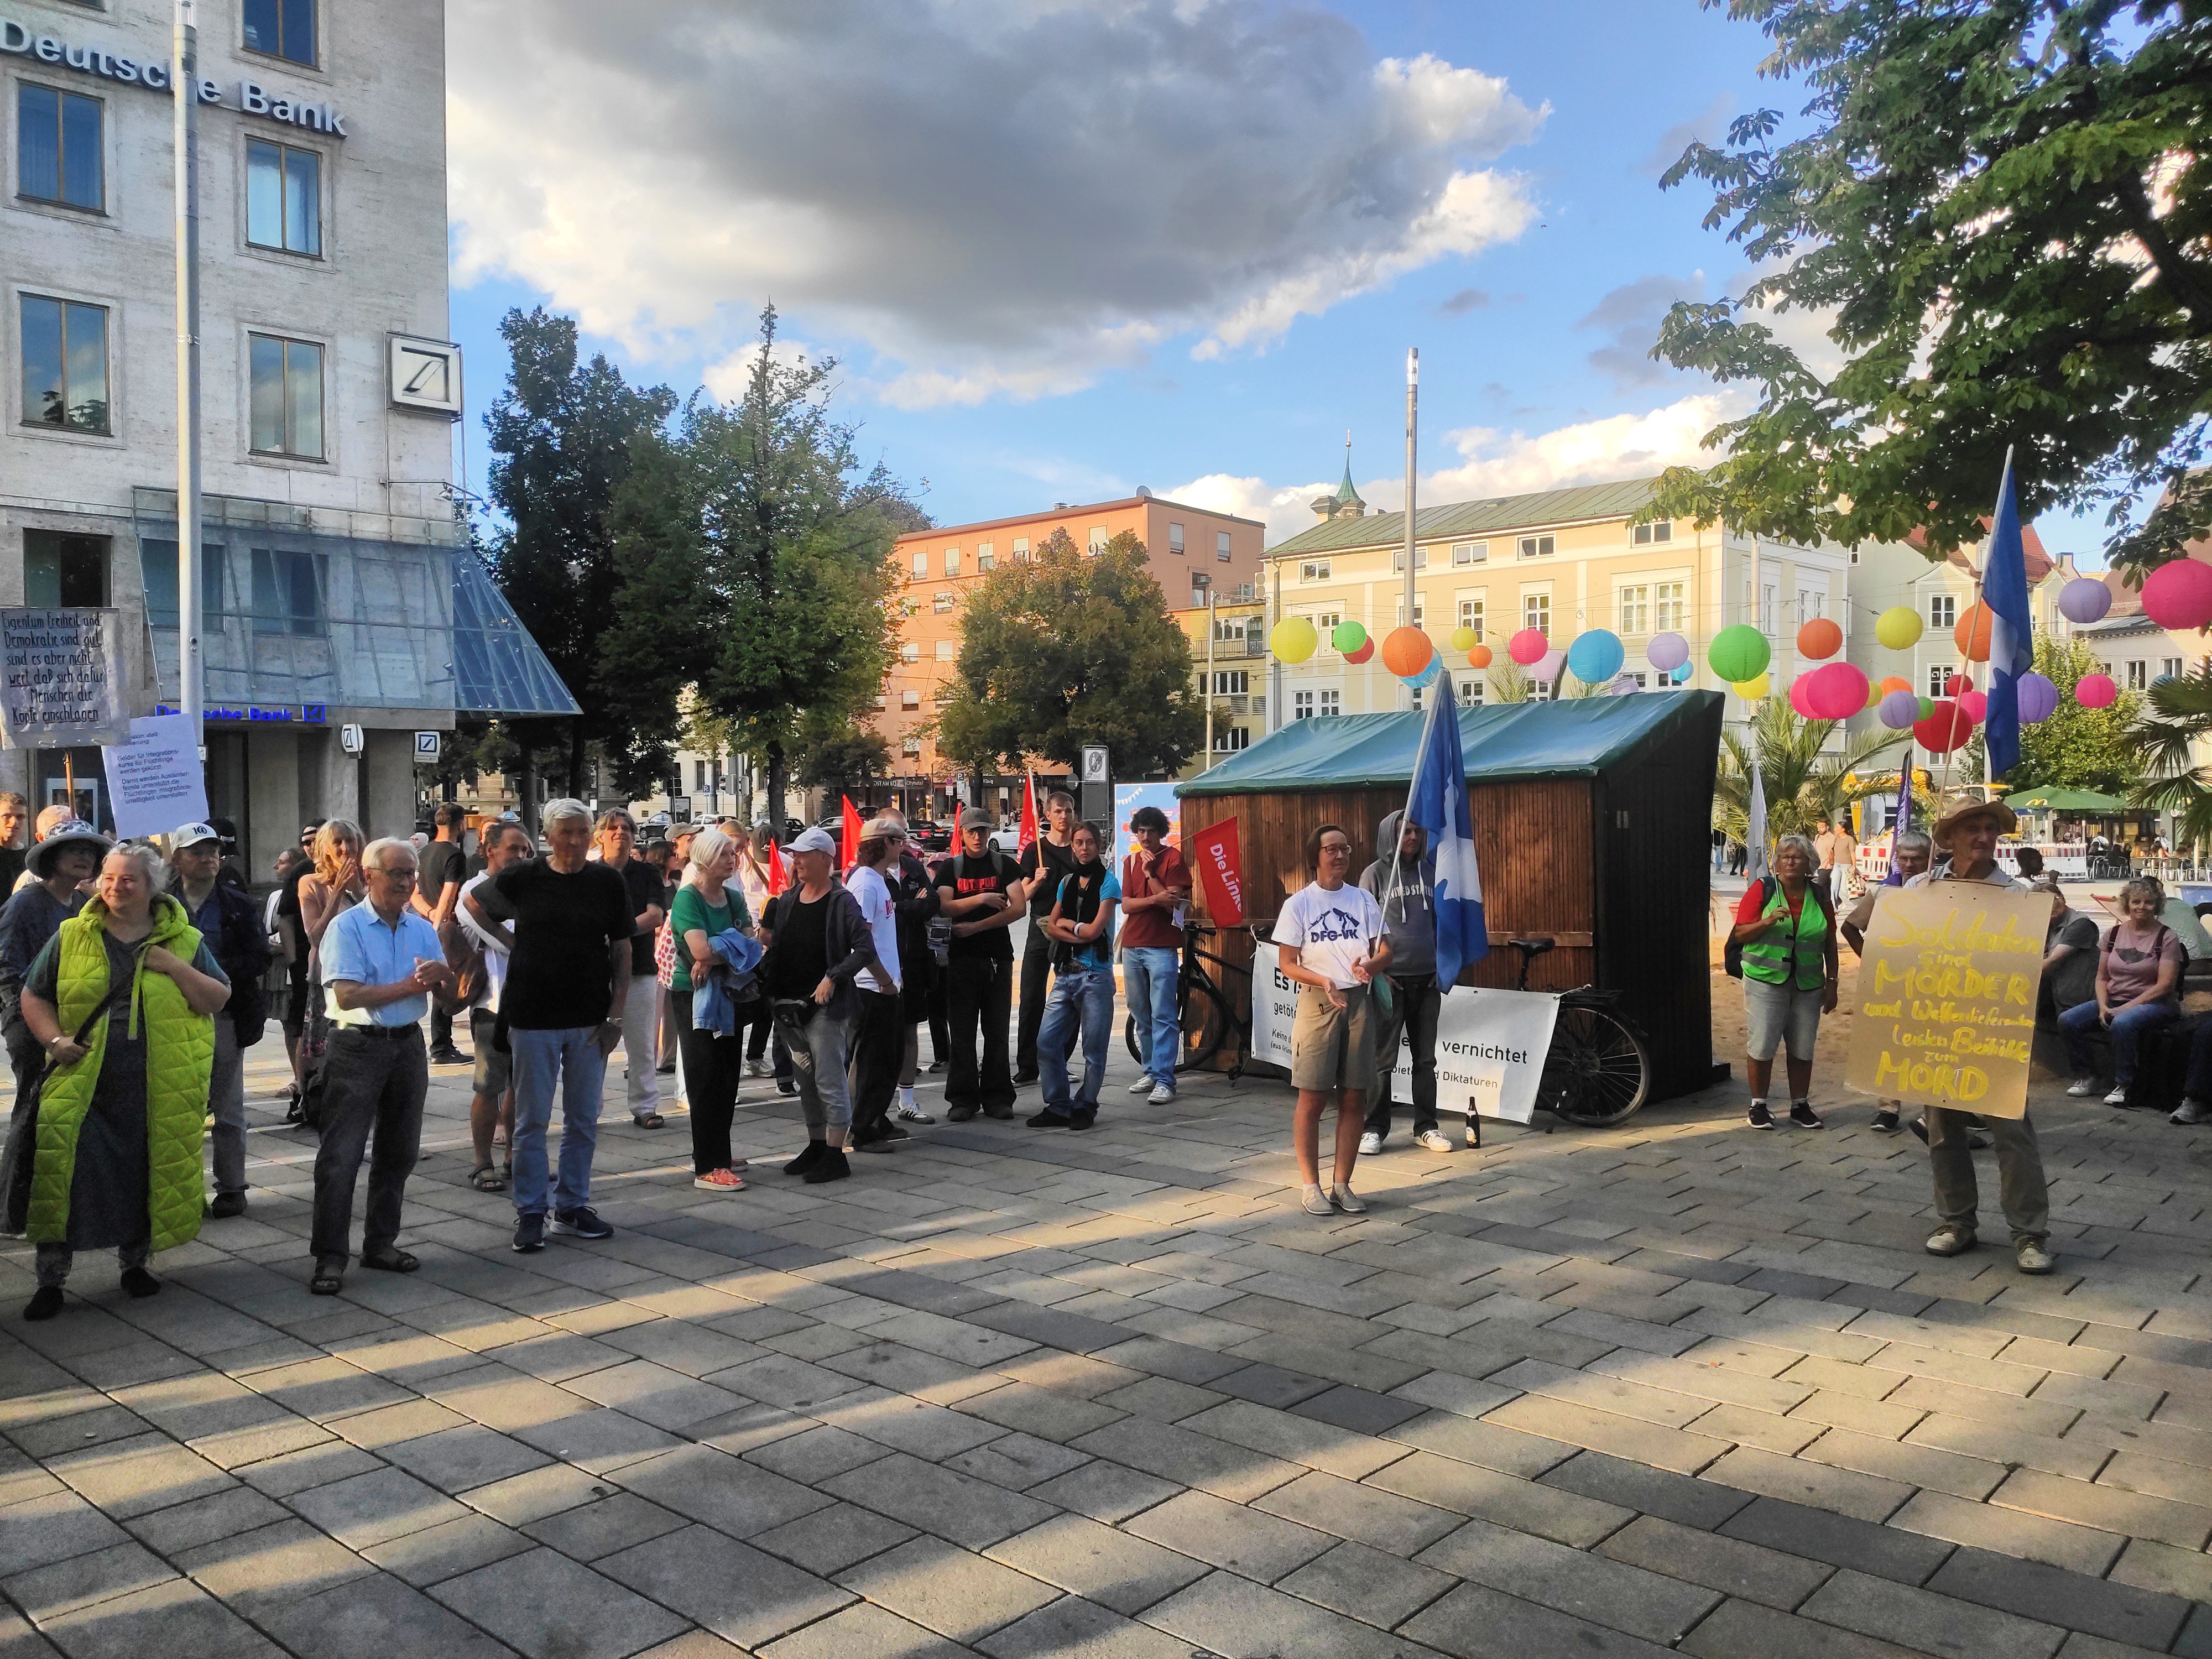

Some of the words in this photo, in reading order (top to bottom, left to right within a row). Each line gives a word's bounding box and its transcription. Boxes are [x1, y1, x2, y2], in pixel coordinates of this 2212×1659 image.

[0, 17, 221, 102] Deutsce
[241, 79, 347, 137] Bank
[2, 612, 44, 630] Eigentum
[47, 612, 81, 627] Freiheit
[84, 611, 101, 627] und
[4, 630, 58, 647] Demokratie
[61, 629, 80, 646] sind
[84, 628, 102, 647] gut
[7, 650, 27, 666] sind
[32, 655, 41, 665] es
[44, 650, 65, 664] aber
[70, 649, 93, 665] nicht
[8, 669, 32, 685] wert
[57, 667, 74, 683] sich
[30, 686, 75, 703] Menschen
[77, 686, 93, 701] die
[42, 705, 99, 723] einschlagen
[155, 704, 242, 720] Desche
[249, 707, 293, 721] Bank
[1210, 843, 1227, 870] Die
[1879, 893, 2041, 955] Soldaten
[1311, 928, 1359, 943] DFG-VK
[1274, 967, 1289, 991] Es
[1863, 1000, 1901, 1018] und
[1271, 1027, 1287, 1042] Keine
[1270, 1040, 1281, 1050] (aus
[1442, 1040, 1527, 1064] vernichtet
[1924, 1051, 1959, 1063] zum
[1443, 1071, 1498, 1089] Diktaturen
[1875, 1050, 1989, 1101] MORD
